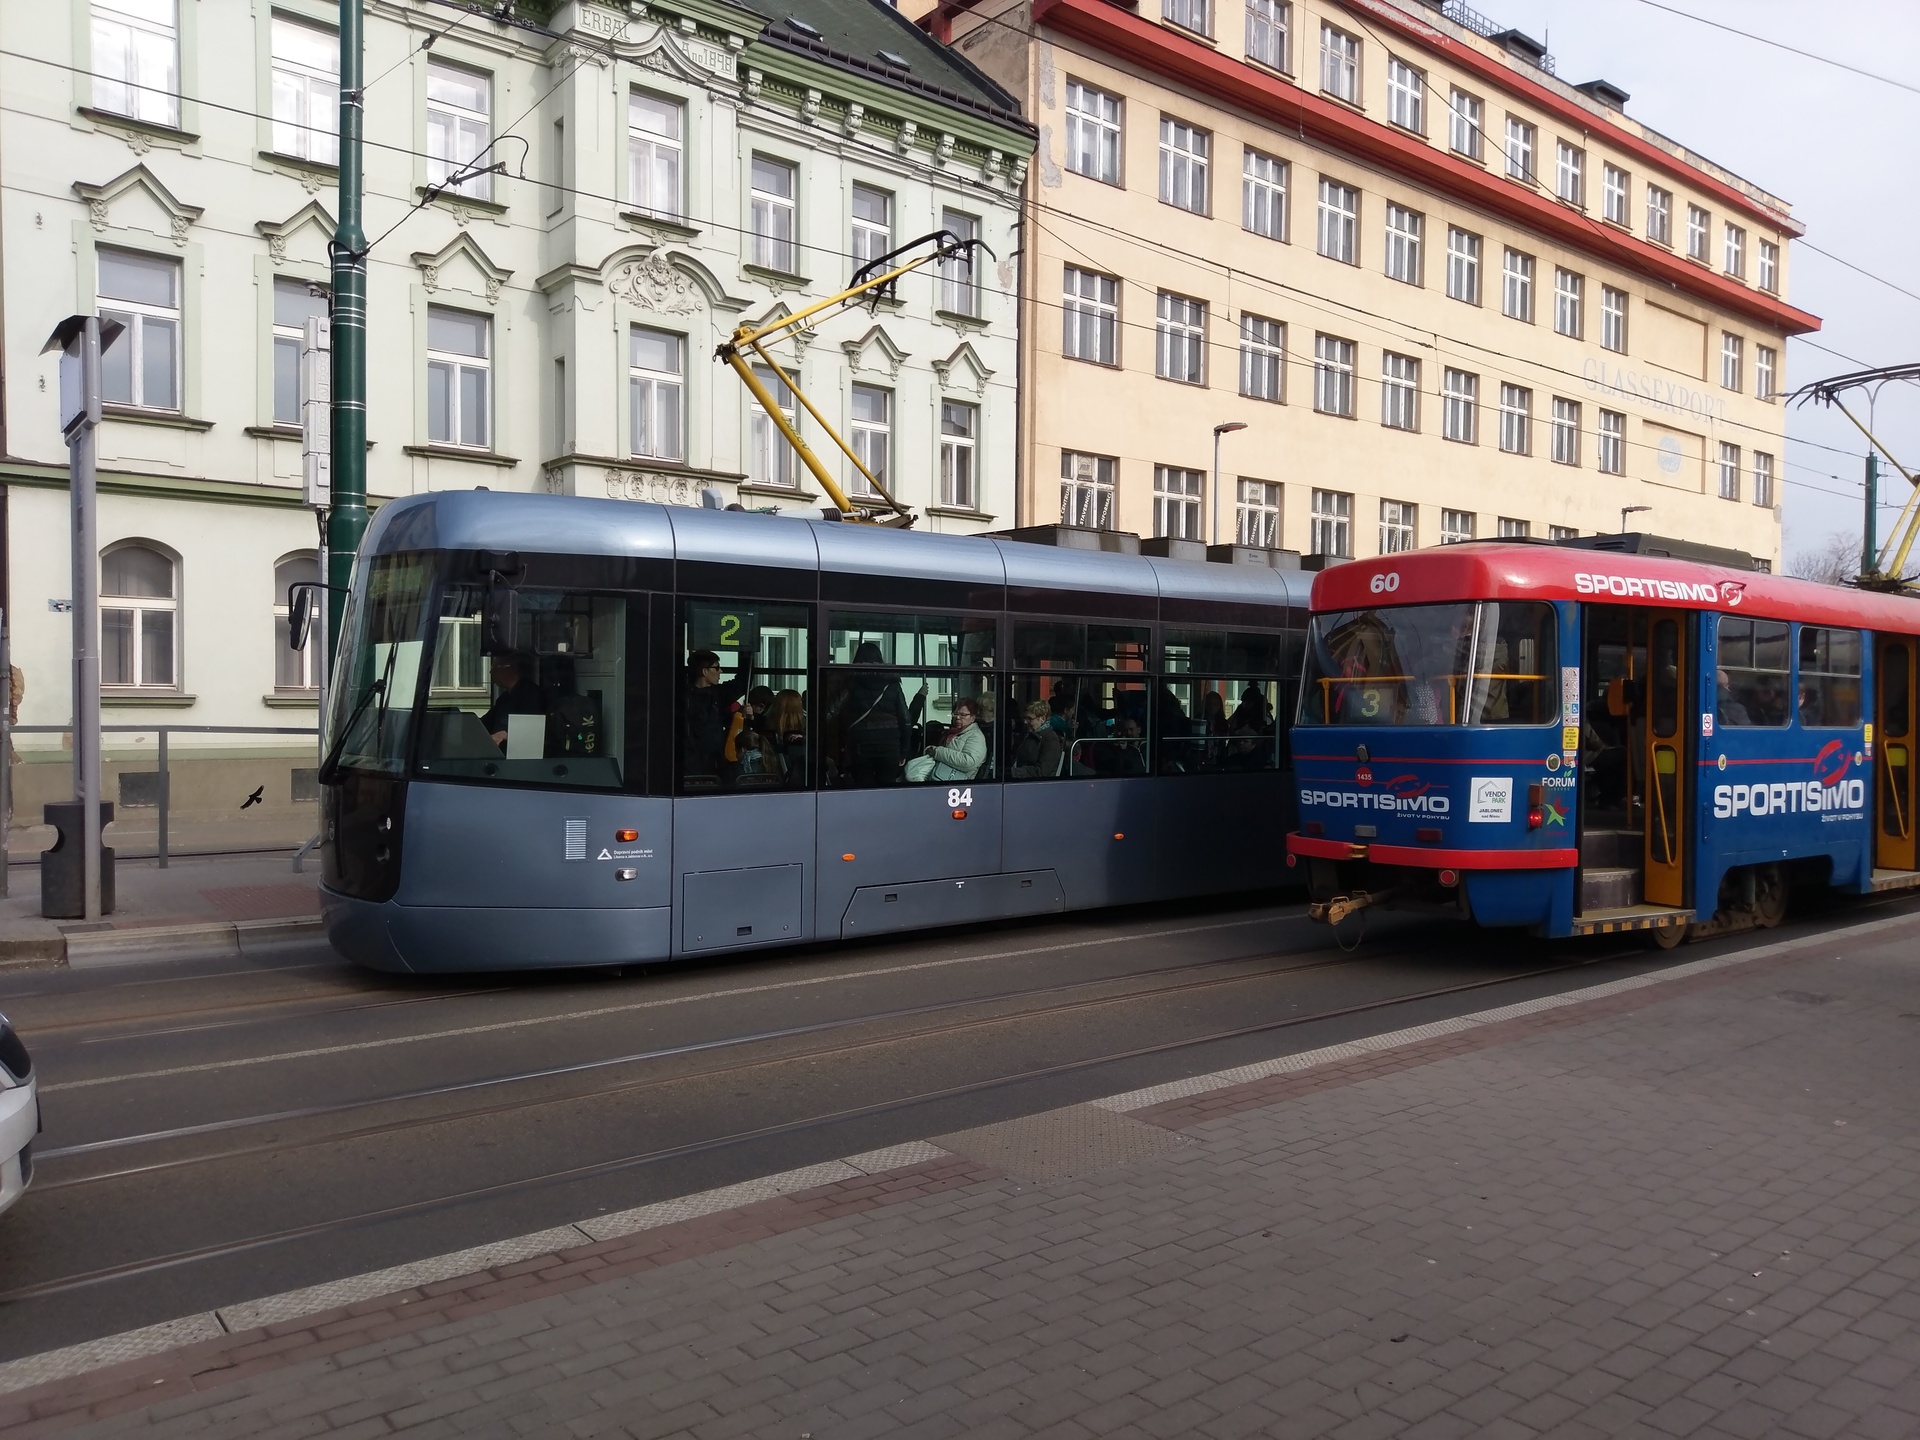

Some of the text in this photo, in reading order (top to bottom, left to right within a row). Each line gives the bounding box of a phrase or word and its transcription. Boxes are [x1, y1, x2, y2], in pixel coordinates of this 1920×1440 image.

[1583, 357, 1726, 427] GLASSEXPORT
[1370, 573, 1400, 594] 60
[1574, 573, 1717, 603] SPORTISIMO
[720, 614, 740, 646] 2
[1361, 689, 1381, 717] 3
[1357, 773, 1372, 781] 1435
[1542, 777, 1576, 787] FORUM
[947, 788, 973, 808] 84
[1300, 789, 1450, 813] SPORTISIMO
[1484, 790, 1507, 798] VENDO
[1713, 779, 1865, 819] SPORTISIMO
